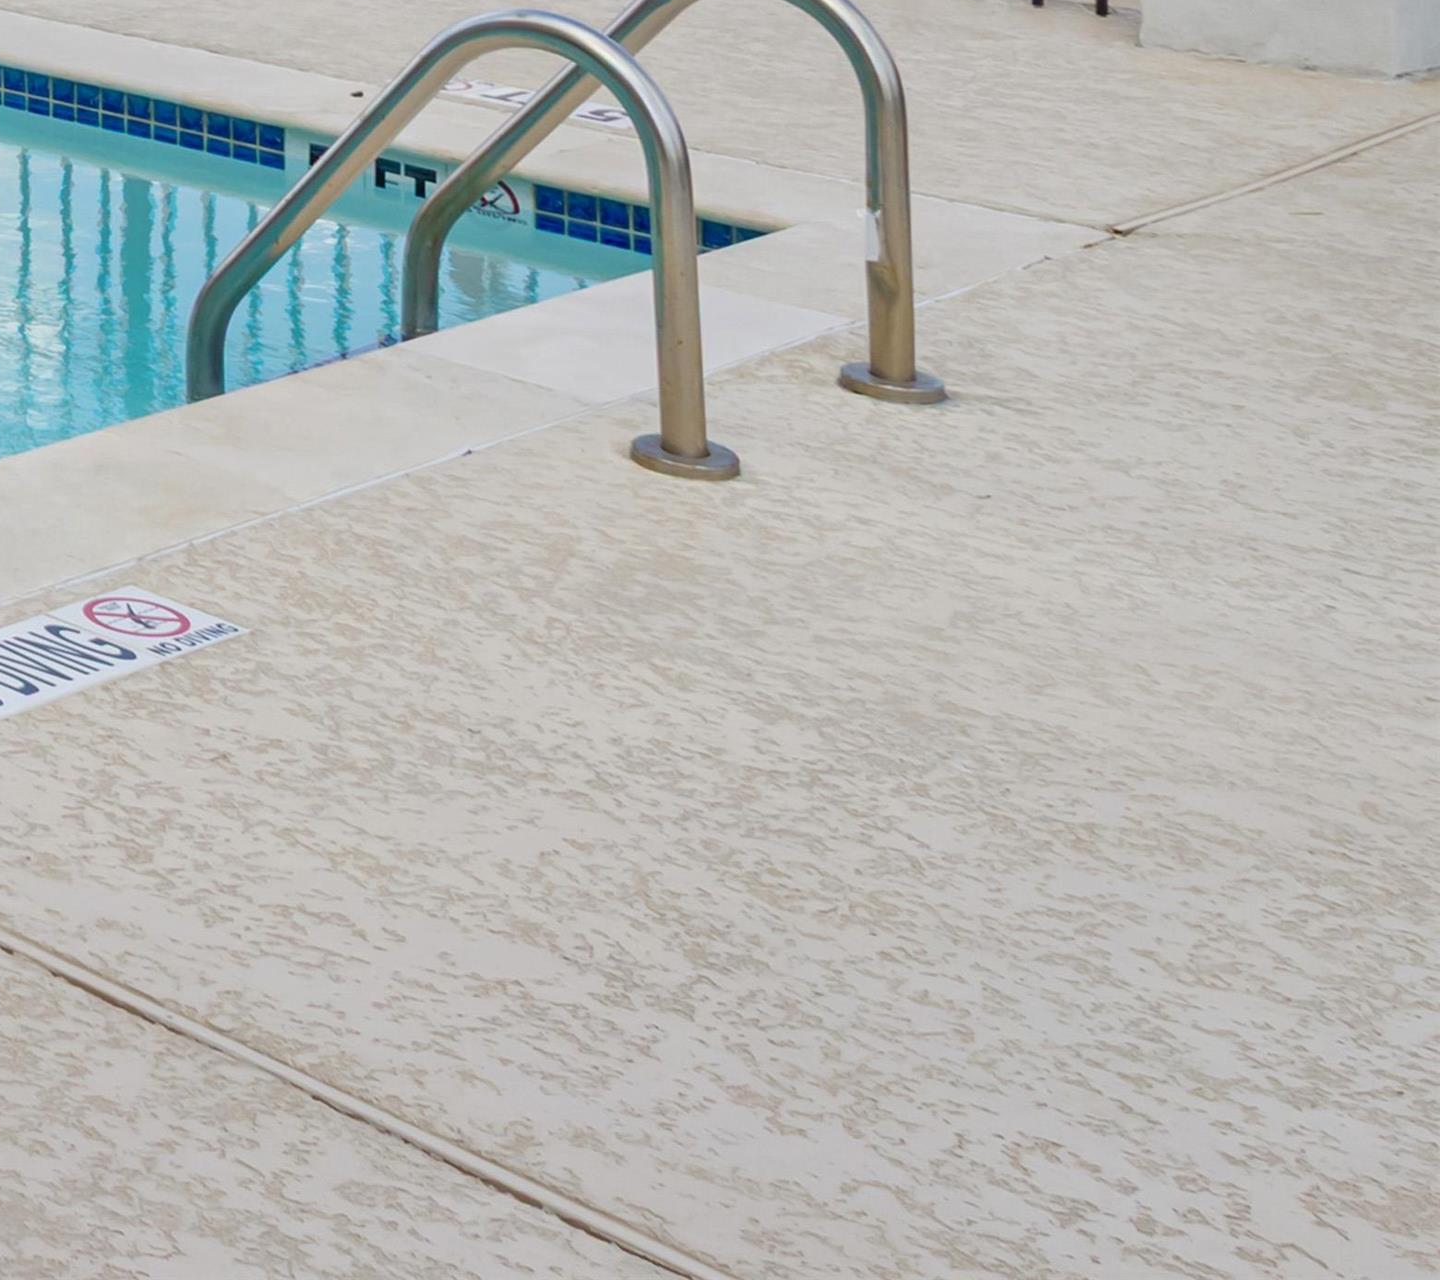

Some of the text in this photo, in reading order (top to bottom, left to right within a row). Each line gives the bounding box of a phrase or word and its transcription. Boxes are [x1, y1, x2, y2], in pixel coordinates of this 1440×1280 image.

[375, 157, 437, 199] FT
[146, 622, 240, 657] NO DIVING
